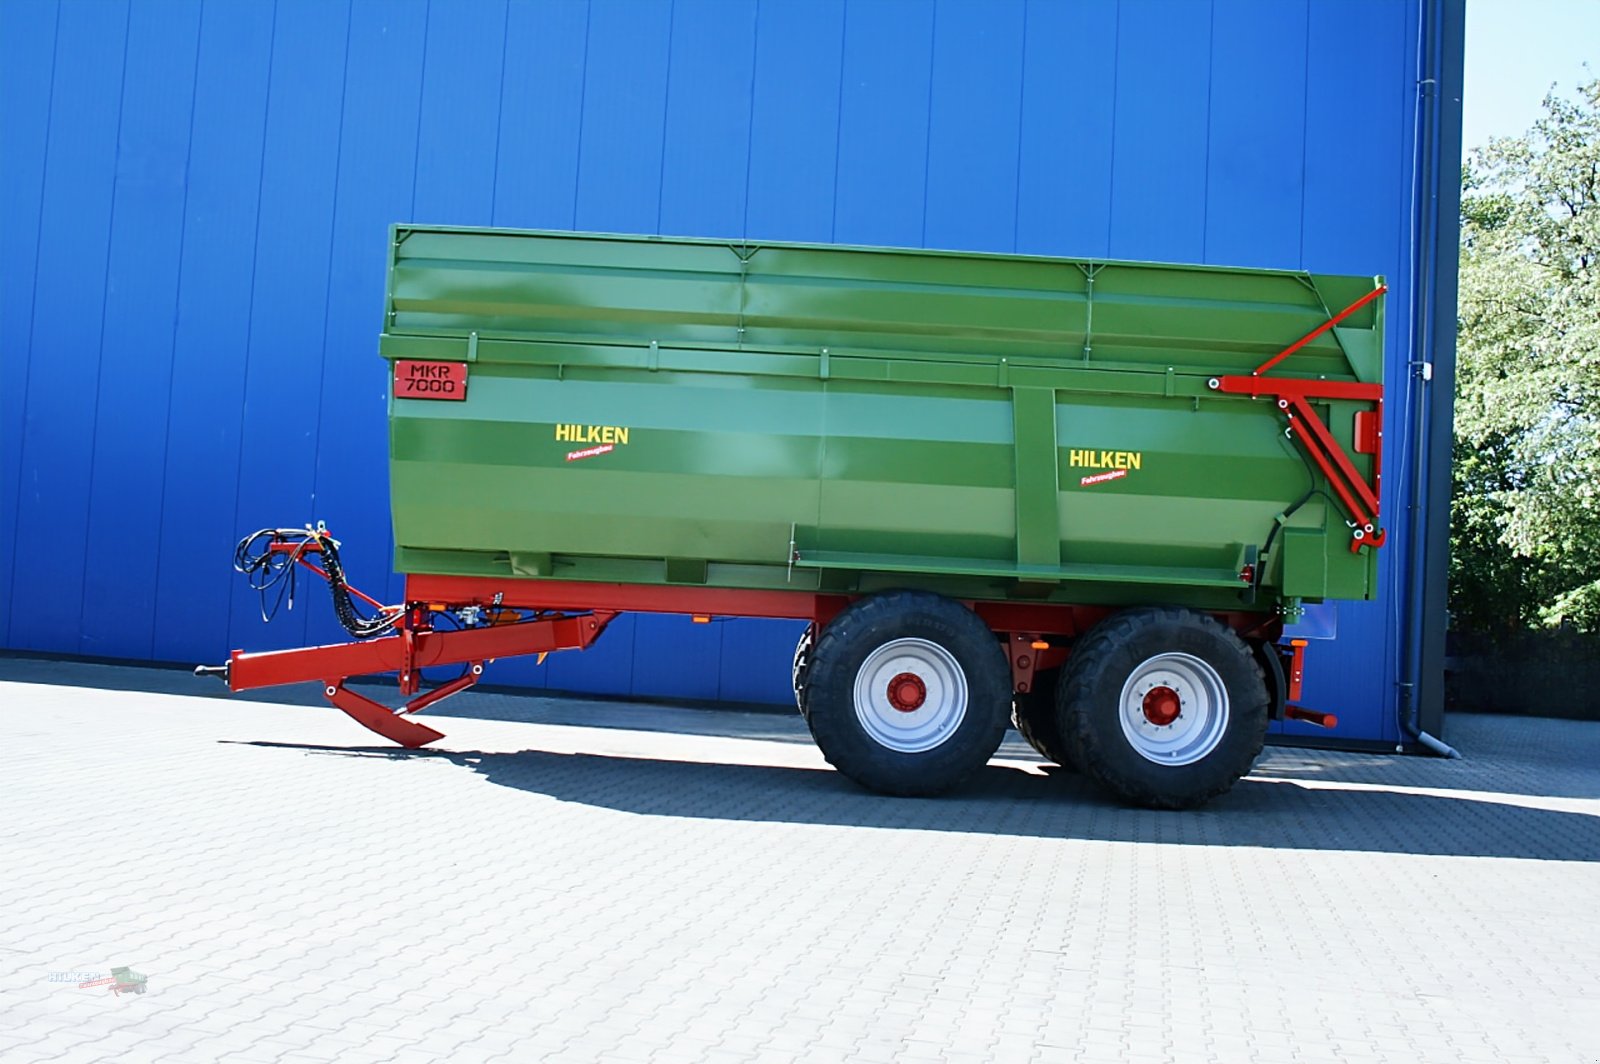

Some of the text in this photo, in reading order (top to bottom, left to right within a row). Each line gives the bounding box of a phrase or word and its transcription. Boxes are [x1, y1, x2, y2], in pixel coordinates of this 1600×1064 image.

[410, 364, 450, 378] MKR
[404, 378, 455, 393] 7000
[555, 423, 629, 444] HILKEN
[1069, 449, 1141, 470] HILKEN
